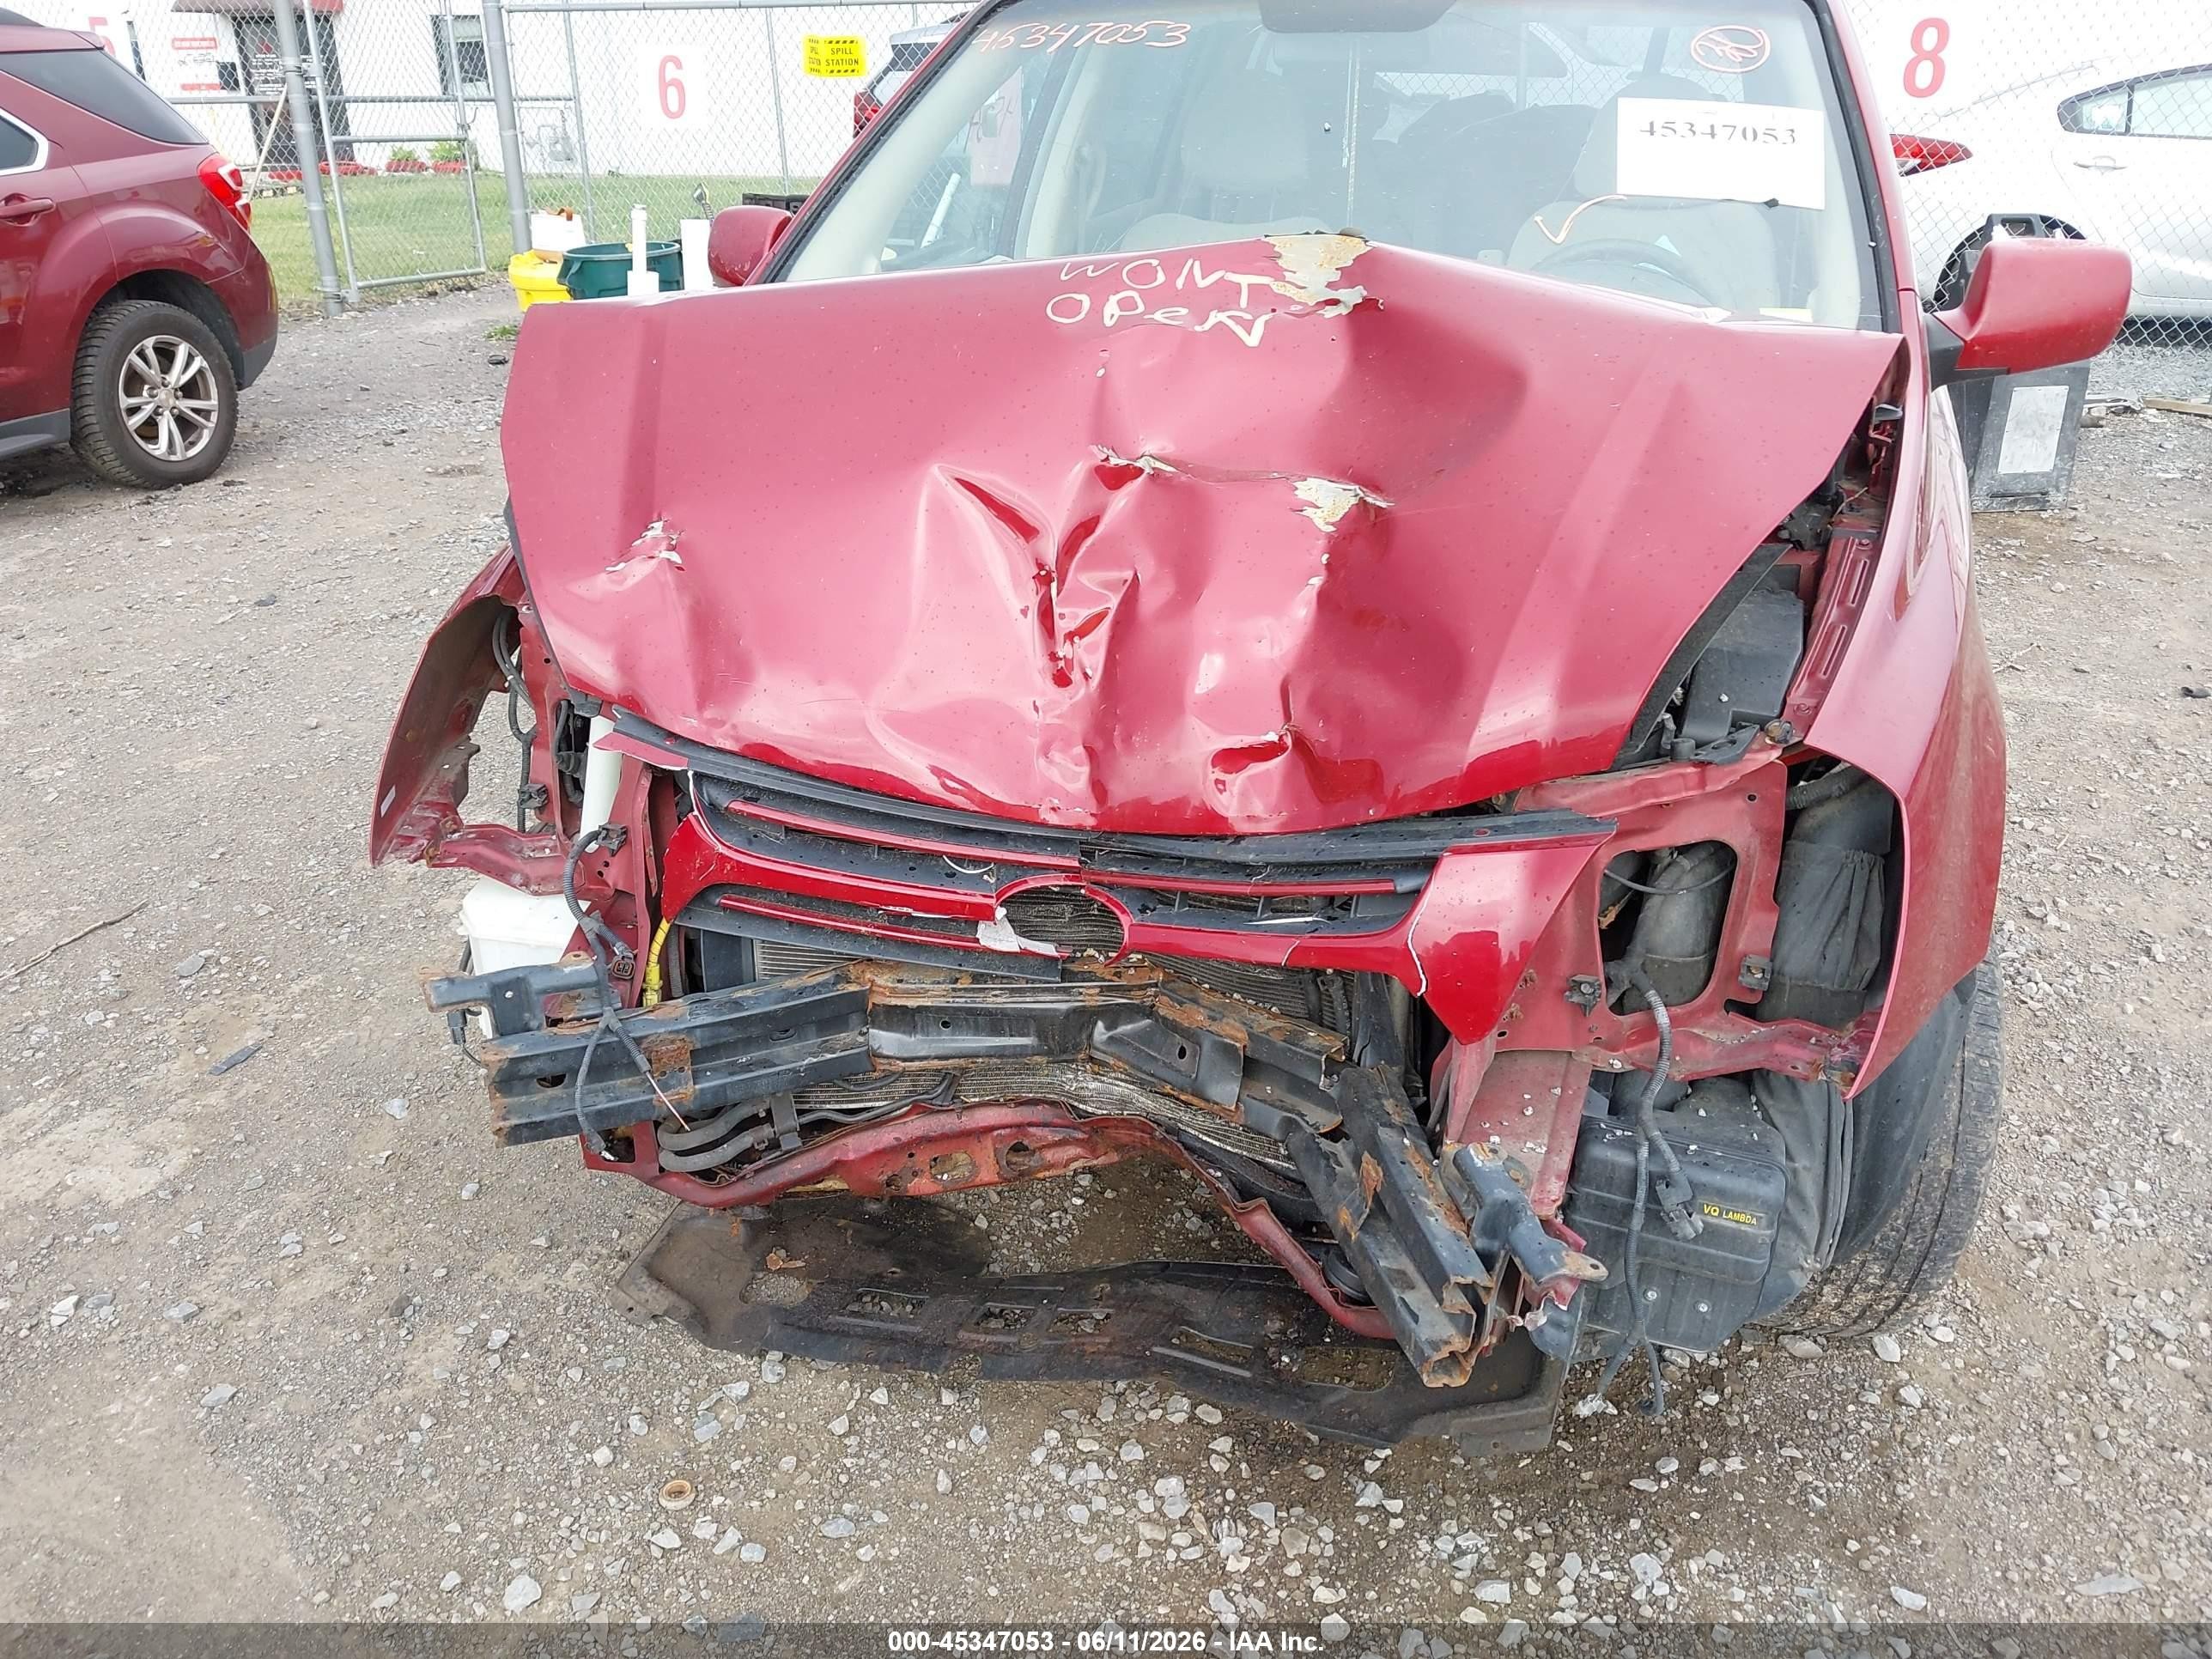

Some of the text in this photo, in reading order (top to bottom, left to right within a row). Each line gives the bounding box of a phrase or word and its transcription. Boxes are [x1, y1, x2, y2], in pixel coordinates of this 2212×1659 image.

[825, 58, 859, 67] STATION
[1903, 17, 1950, 98] 8
[659, 55, 685, 119] 6
[1639, 120, 1796, 145] 45347053
[1704, 1204, 1758, 1225] VQ LAMBDA
